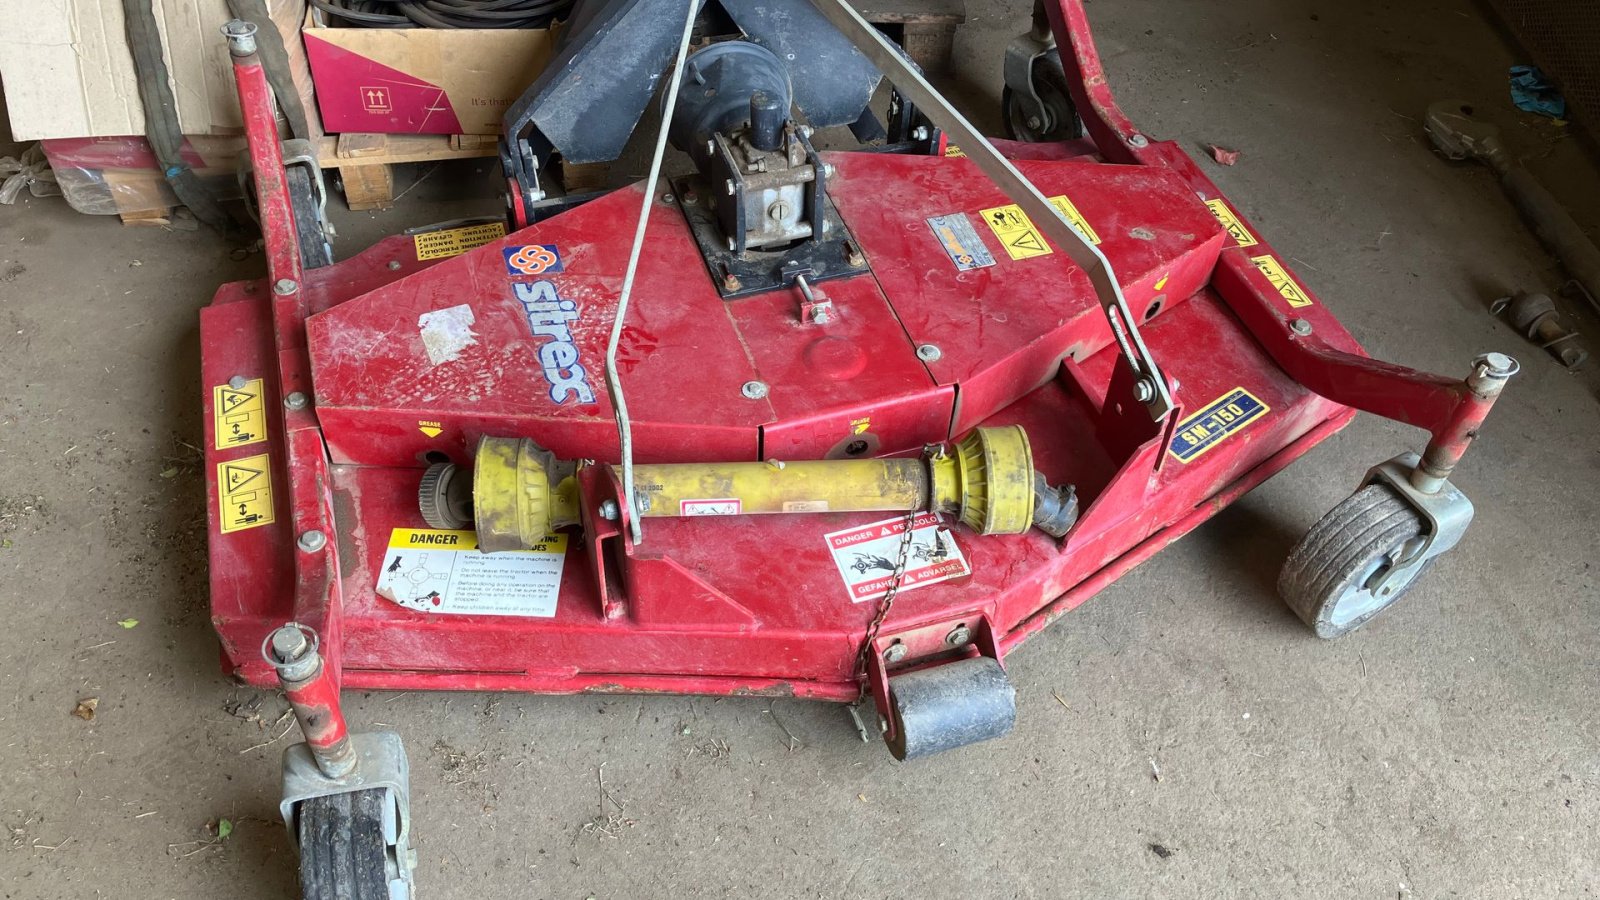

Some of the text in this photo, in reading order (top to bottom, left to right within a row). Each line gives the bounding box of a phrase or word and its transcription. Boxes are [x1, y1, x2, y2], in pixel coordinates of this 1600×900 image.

[459, 234, 498, 243] ATTENTION
[512, 279, 597, 406] sitrex
[1181, 403, 1244, 445] SM-150
[410, 534, 458, 545] DANGER
[834, 516, 937, 546] DANGER PECOLO
